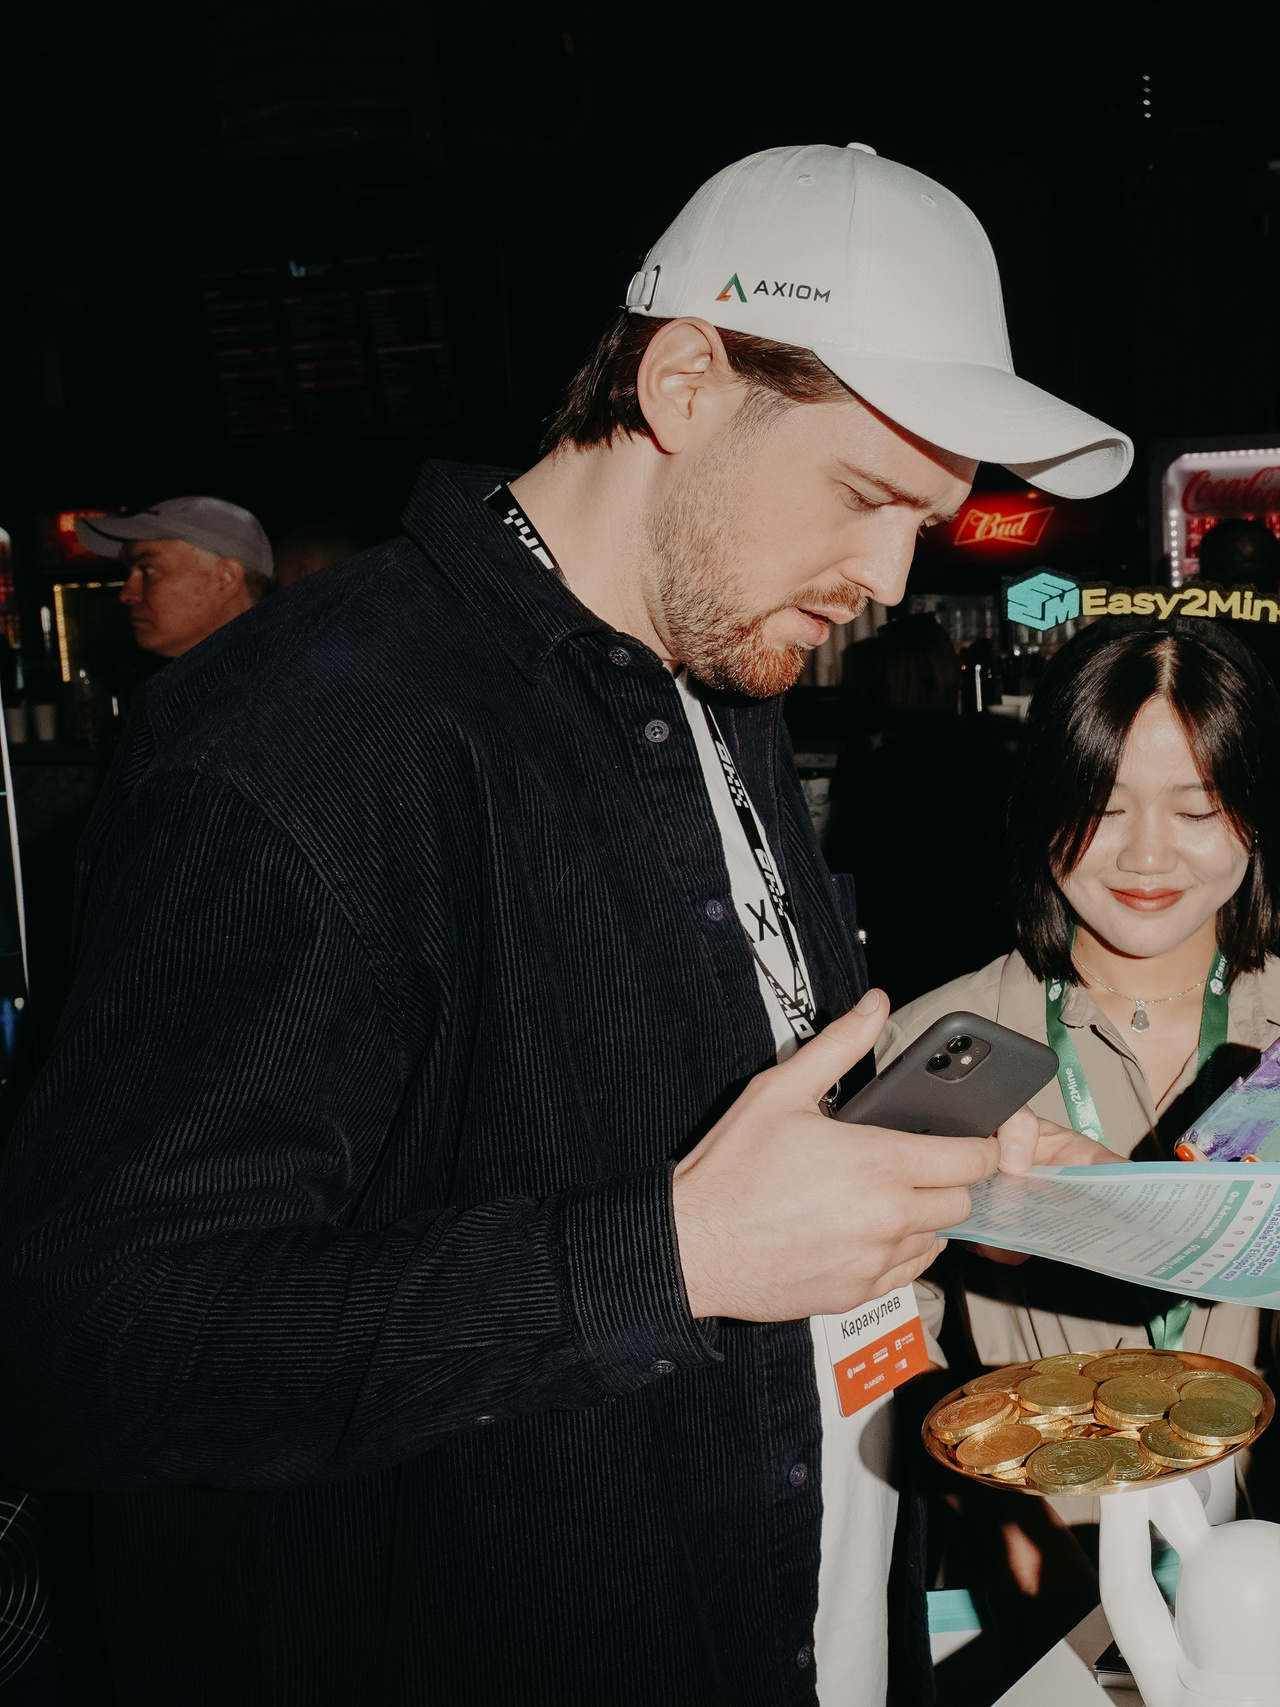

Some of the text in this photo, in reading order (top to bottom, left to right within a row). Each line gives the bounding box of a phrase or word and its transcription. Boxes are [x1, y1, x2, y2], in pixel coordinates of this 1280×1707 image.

[753, 280, 831, 303] AXIOM
[970, 512, 1031, 540] Bud
[1065, 1067, 1088, 1128] Easy2Mine
[1199, 1191, 1240, 1239] Our Advantages
[1231, 1247, 1260, 1271] Ethiopia
[1247, 1257, 1273, 1277] Space
[1219, 1269, 1238, 1281] now
[840, 1296, 901, 1339] Каракулев
